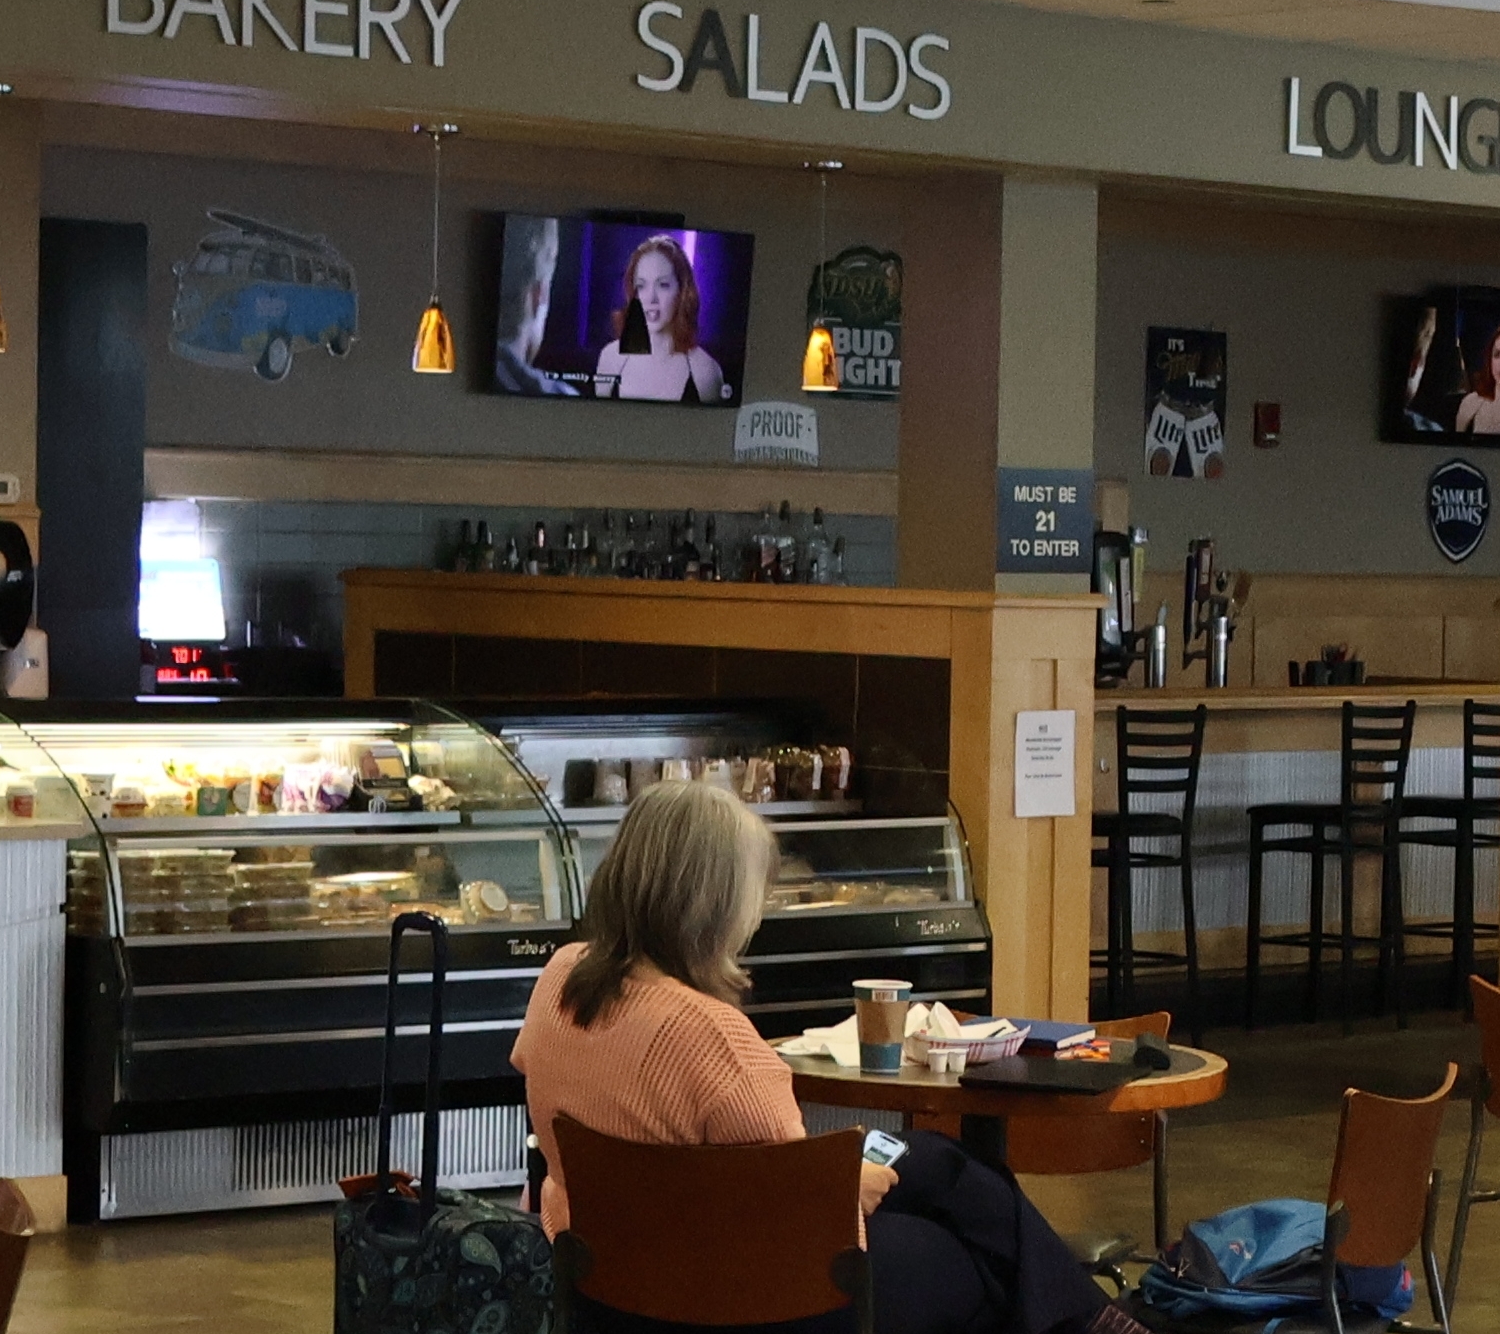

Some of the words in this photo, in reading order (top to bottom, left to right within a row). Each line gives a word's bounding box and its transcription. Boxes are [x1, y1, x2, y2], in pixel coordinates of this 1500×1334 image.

[636, 0, 952, 121] SALADS
[832, 326, 894, 357] BUD
[838, 357, 901, 387] IGHT
[750, 409, 804, 440] PROOF
[1014, 485, 1054, 503] MUST
[1058, 486, 1077, 503] BE
[1431, 484, 1488, 509] SAMUEL
[1035, 510, 1056, 532] 21
[1435, 505, 1483, 527] ADAMS
[1010, 538, 1030, 556] TO
[1034, 539, 1080, 557] ENTER
